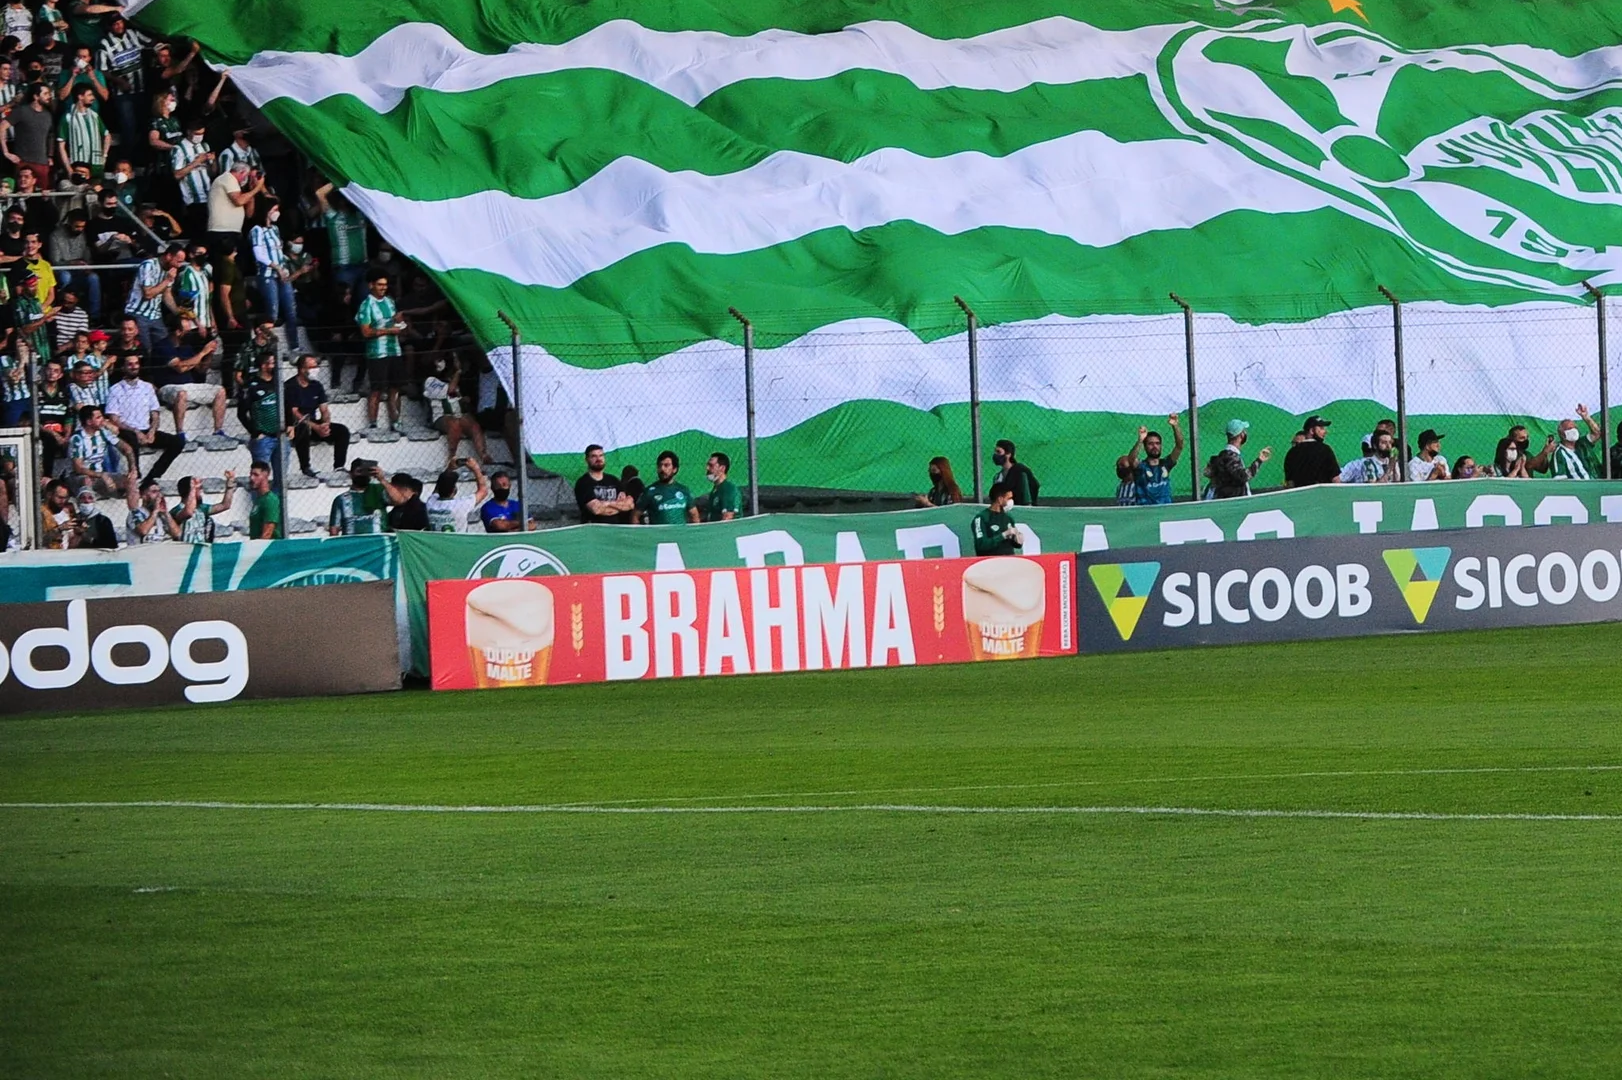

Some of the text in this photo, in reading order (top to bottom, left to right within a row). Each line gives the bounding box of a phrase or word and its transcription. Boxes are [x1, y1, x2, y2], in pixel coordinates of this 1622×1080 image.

[602, 562, 917, 681] BRAHMA
[1162, 563, 1373, 628] SICOOB
[0, 599, 249, 703] dog
[486, 662, 532, 682] MALTE
[982, 637, 1025, 655] MALTE
